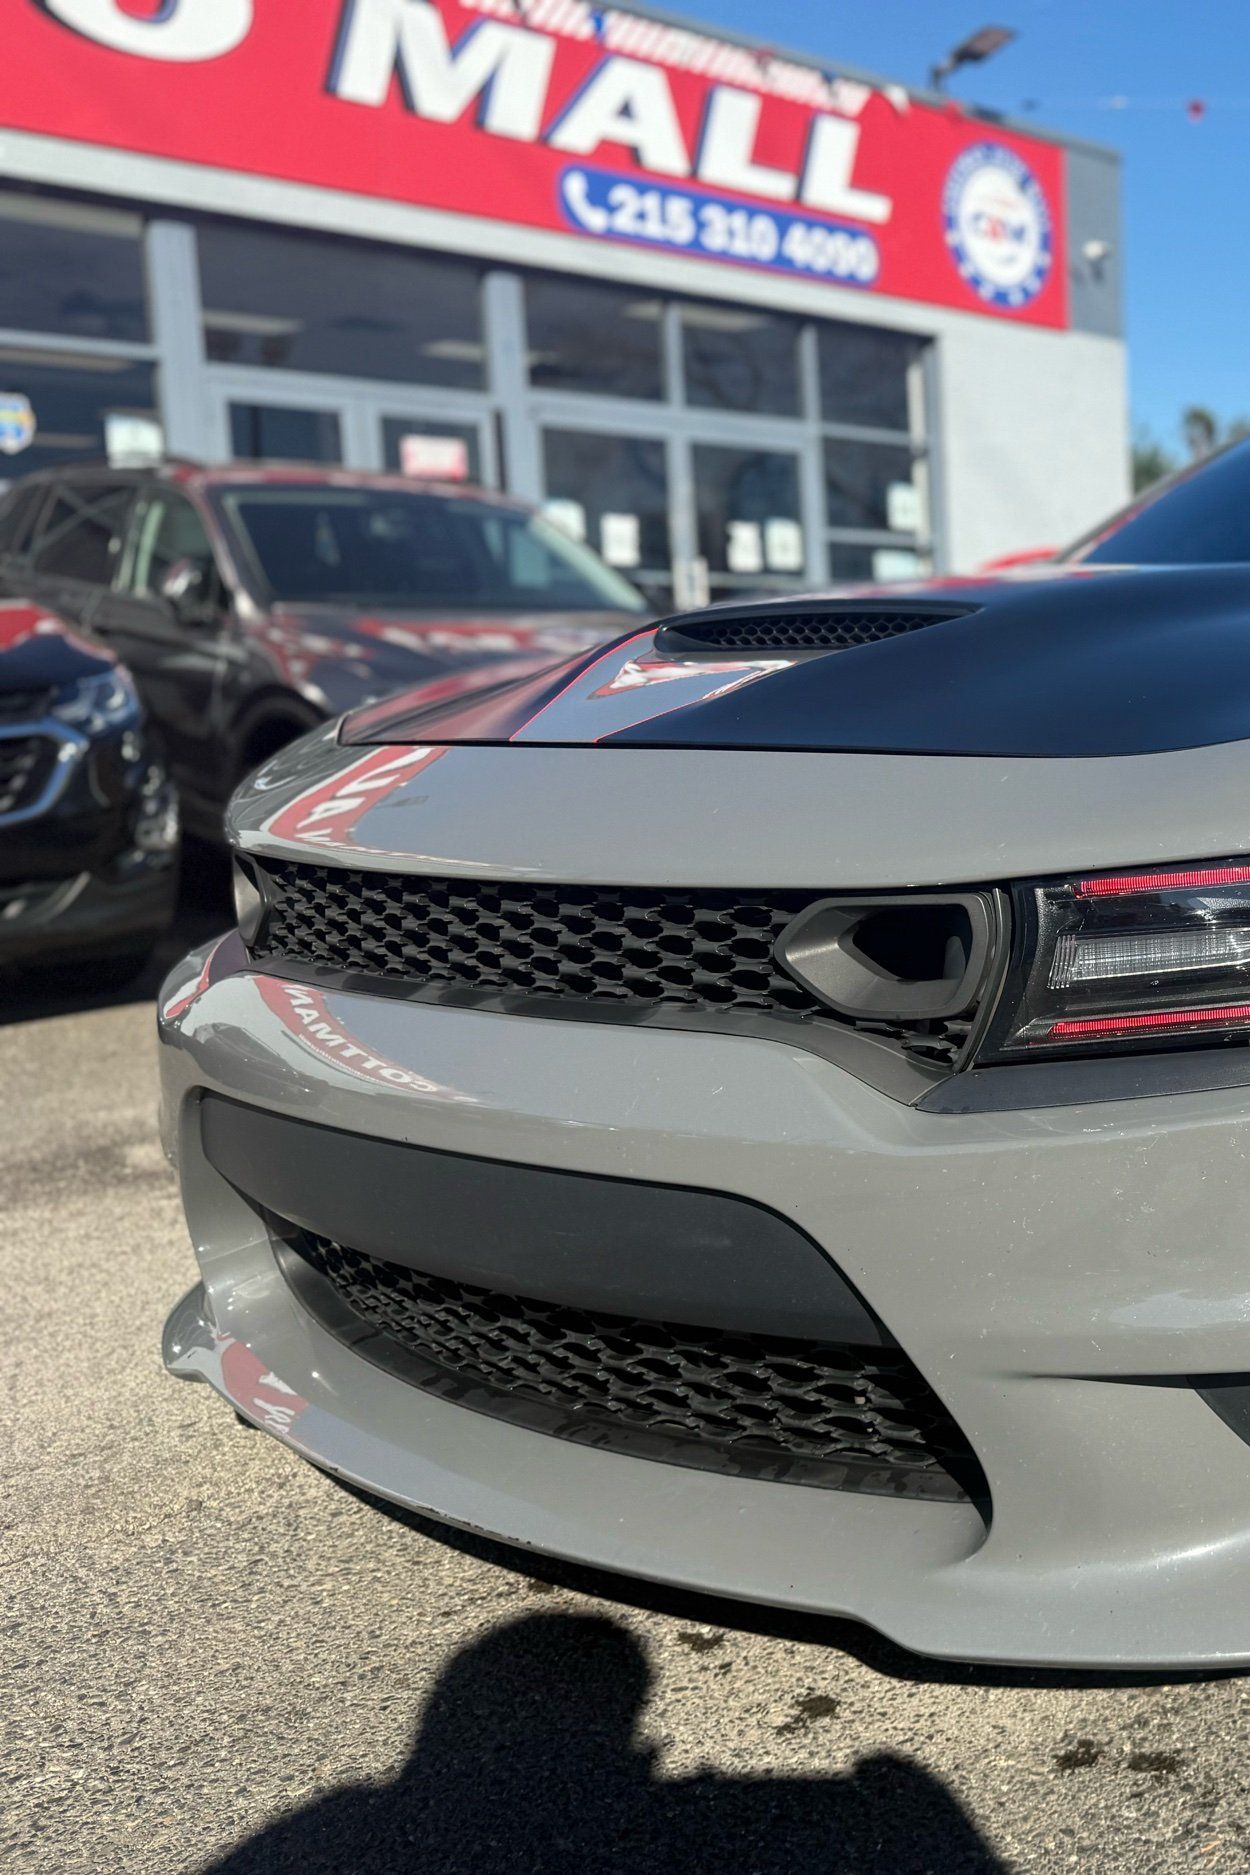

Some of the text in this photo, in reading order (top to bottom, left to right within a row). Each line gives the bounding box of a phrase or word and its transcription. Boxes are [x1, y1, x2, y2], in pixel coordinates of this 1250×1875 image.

[325, 0, 893, 224] MALL
[608, 184, 697, 247] 215
[699, 204, 779, 263] 310
